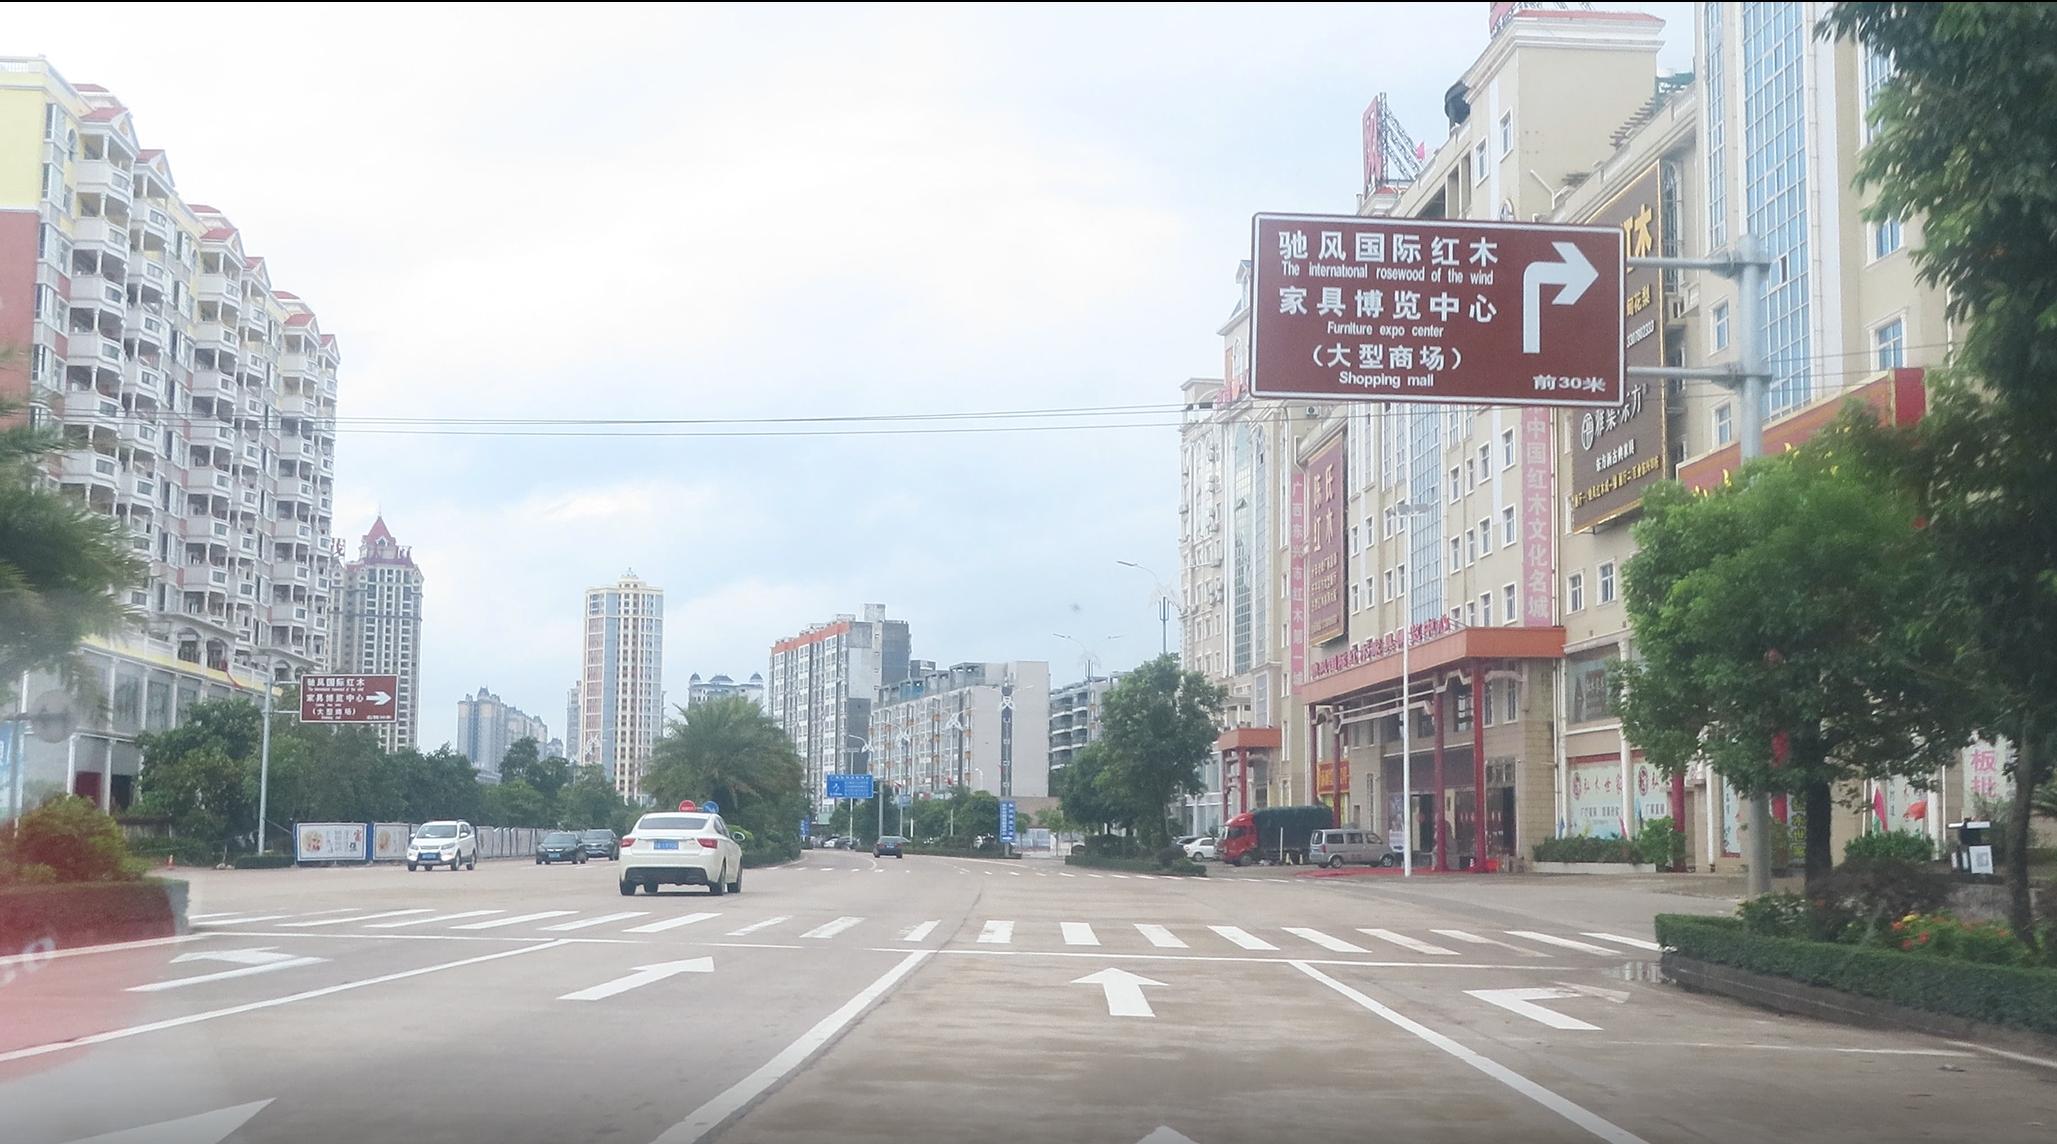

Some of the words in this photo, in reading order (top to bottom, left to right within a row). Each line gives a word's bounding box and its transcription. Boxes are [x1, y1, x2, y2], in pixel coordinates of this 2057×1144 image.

[1278, 230, 1498, 268] 驰风国际红木
[1282, 260, 1300, 276] The
[1308, 262, 1368, 279] international
[1376, 267, 1425, 282] rosewood
[1431, 267, 1443, 283] of
[1448, 268, 1464, 285] the
[1470, 271, 1494, 286] wind
[1278, 285, 1498, 323] 家具博览中心
[1327, 320, 1373, 337] Furniture
[1379, 325, 1406, 339] expo
[1411, 325, 1445, 338] center
[1339, 371, 1401, 389] Shopping
[1407, 373, 1435, 387] mall
[1532, 374, 1607, 392] 前30米
